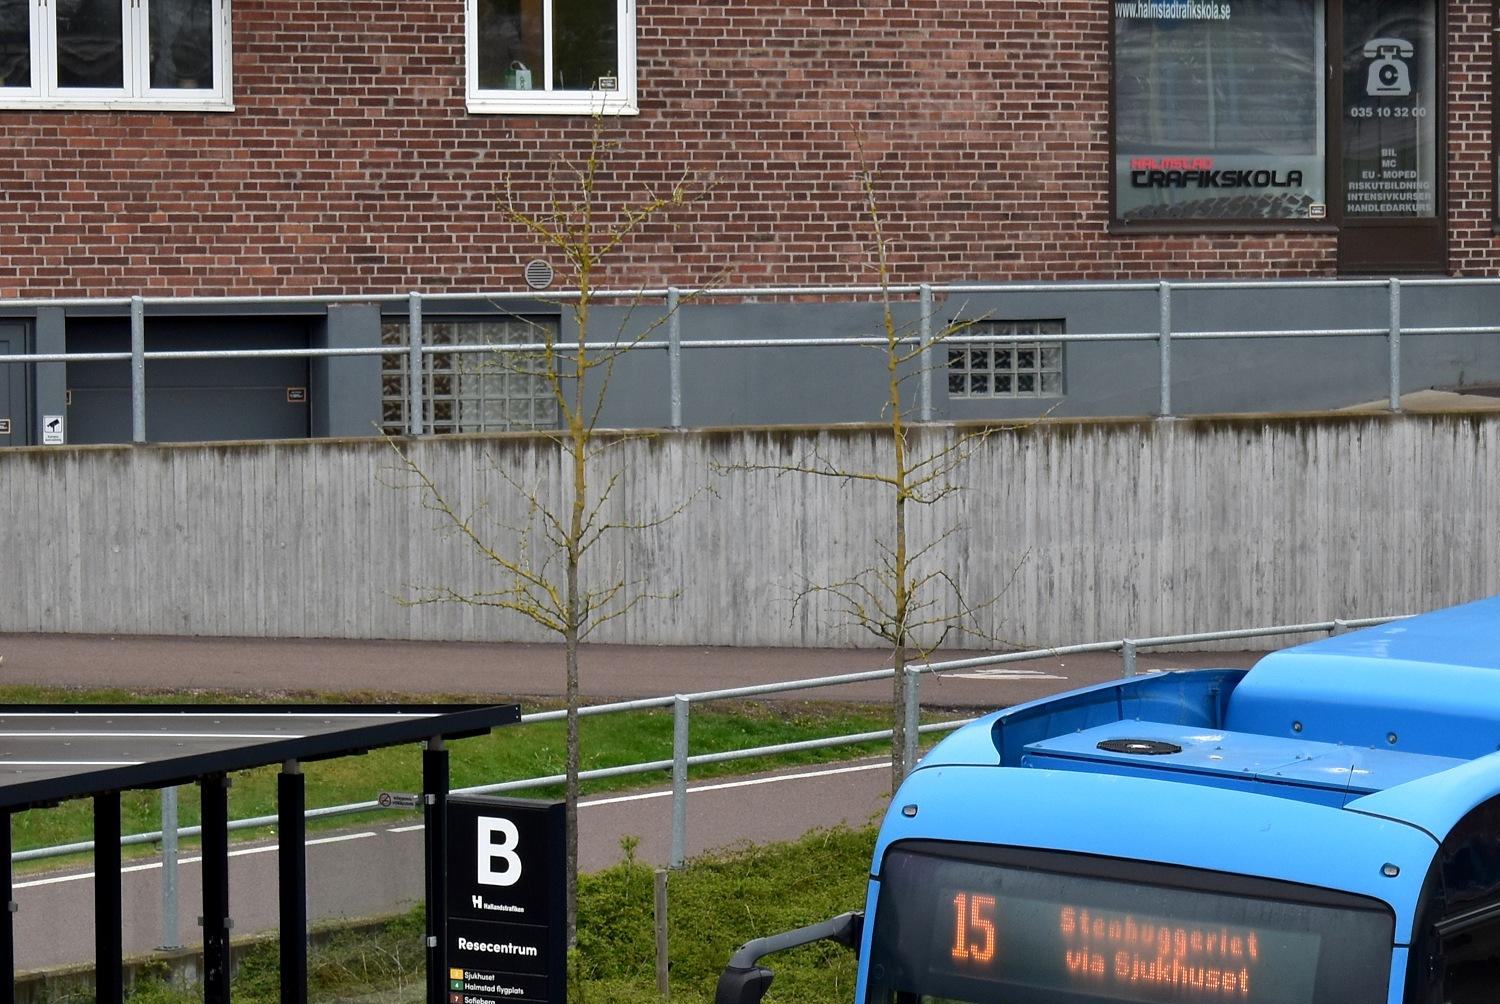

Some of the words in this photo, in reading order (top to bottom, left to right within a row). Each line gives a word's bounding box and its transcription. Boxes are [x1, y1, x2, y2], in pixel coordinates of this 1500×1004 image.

[1115, 1, 1230, 19] www.halmstadtrafikskola.se
[1351, 107, 1373, 117] 035
[1377, 107, 1391, 117] 10
[1394, 107, 1409, 117] 32
[1412, 107, 1427, 117] 00
[1381, 149, 1397, 157] BIL
[1382, 160, 1397, 168] MC
[1362, 171, 1375, 179] EU
[1349, 182, 1430, 190] RISKUTBILDNING
[1347, 193, 1431, 201] INTENSIVKURSER
[478, 816, 522, 886] B
[484, 903, 524, 912] Hallandstrafiken
[951, 891, 996, 962] 15
[458, 937, 538, 956] Resecentrum
[1066, 945, 1105, 975] via
[1115, 951, 1249, 993] Sjukhuset
[465, 971, 495, 981] Sjukhuset
[465, 983, 495, 992] Halmstad
[496, 986, 524, 995] flygplats
